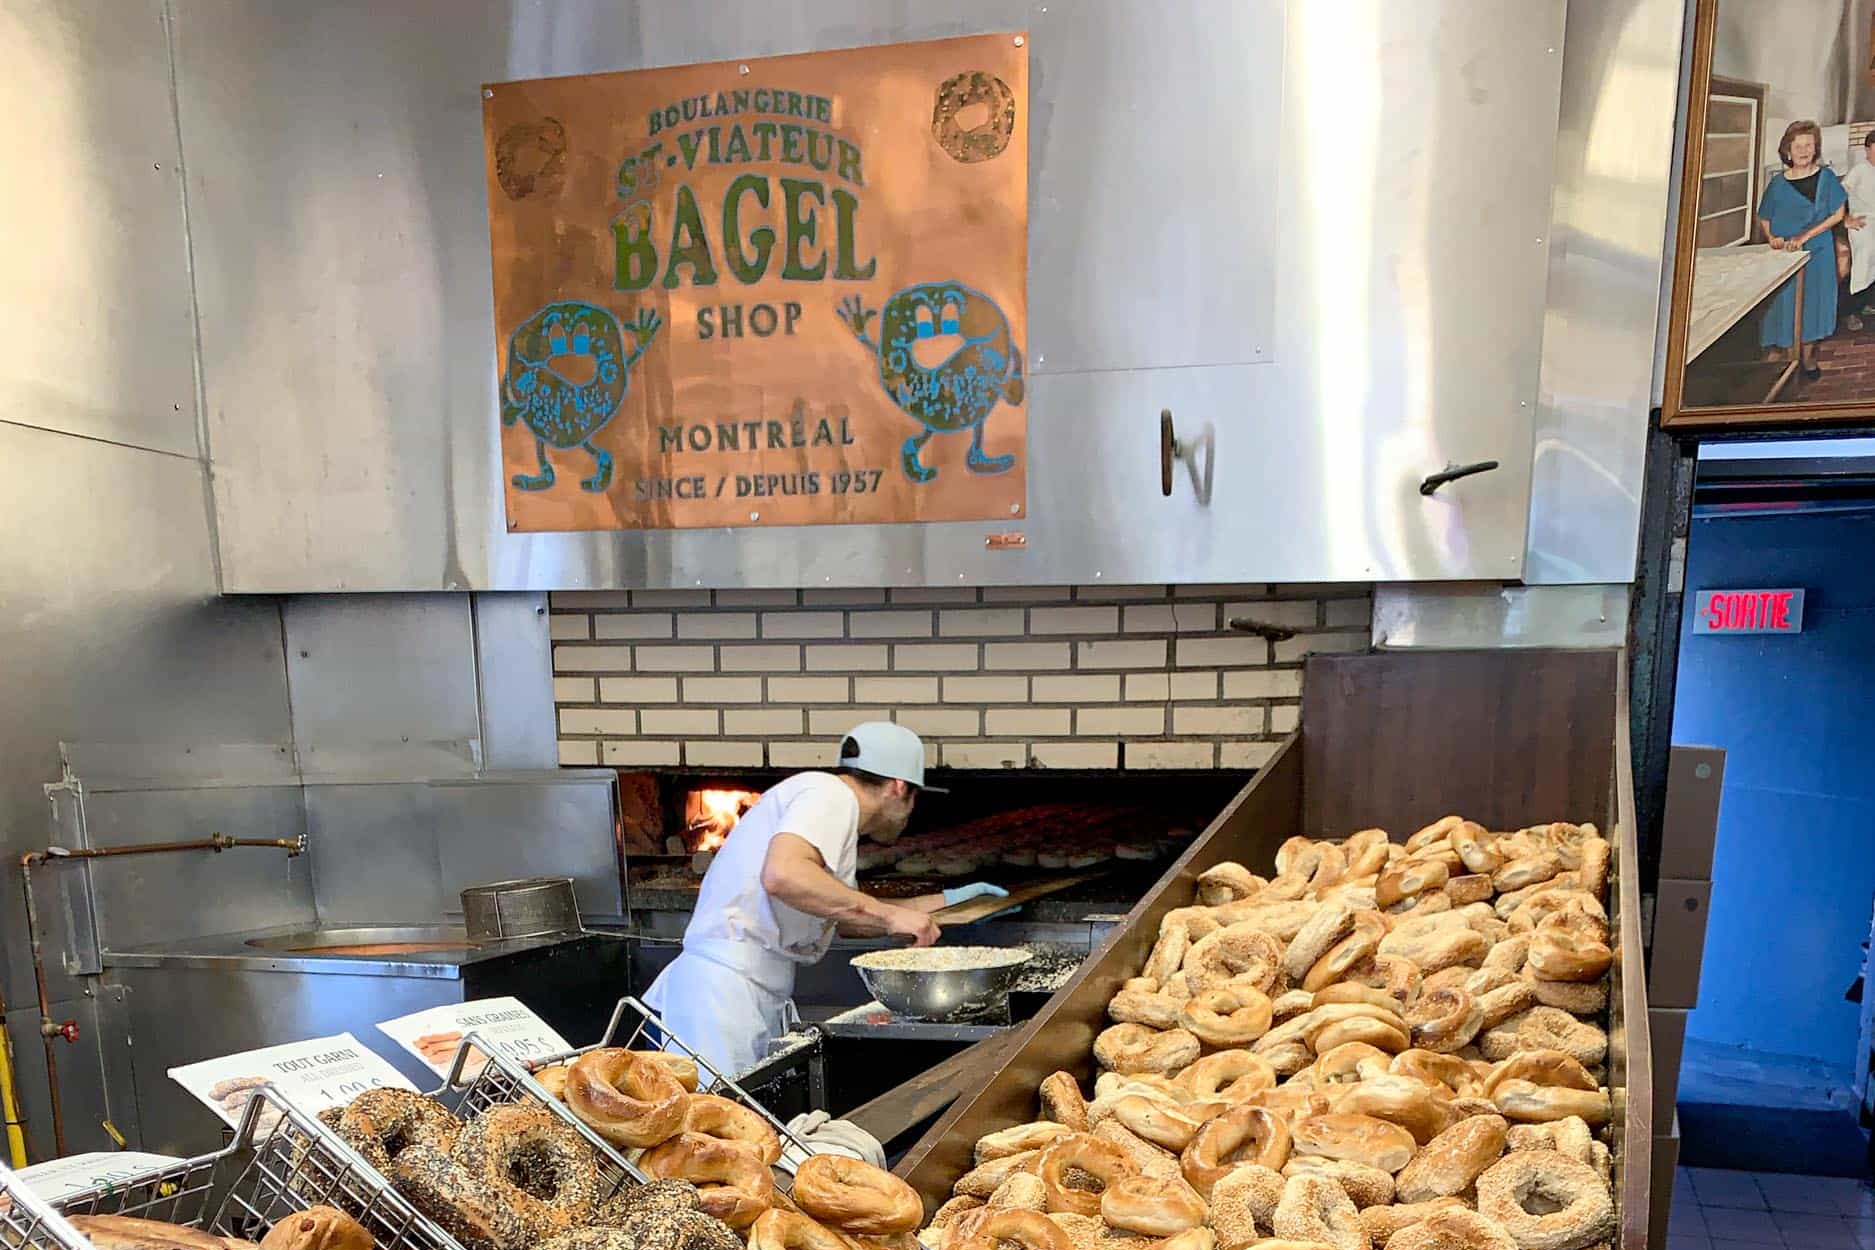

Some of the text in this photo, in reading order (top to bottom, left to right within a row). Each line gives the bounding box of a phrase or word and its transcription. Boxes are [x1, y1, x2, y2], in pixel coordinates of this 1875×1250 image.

[649, 88, 833, 136] BOULANGERIE
[611, 173, 877, 292] BAGEL
[697, 302, 803, 340] SHOP
[635, 476, 706, 499] SINCE
[735, 472, 820, 498] DEPUIS
[831, 470, 883, 494] 1957
[1708, 591, 1794, 631] SORTIE
[272, 1048, 360, 1073] TOUT GARNI
